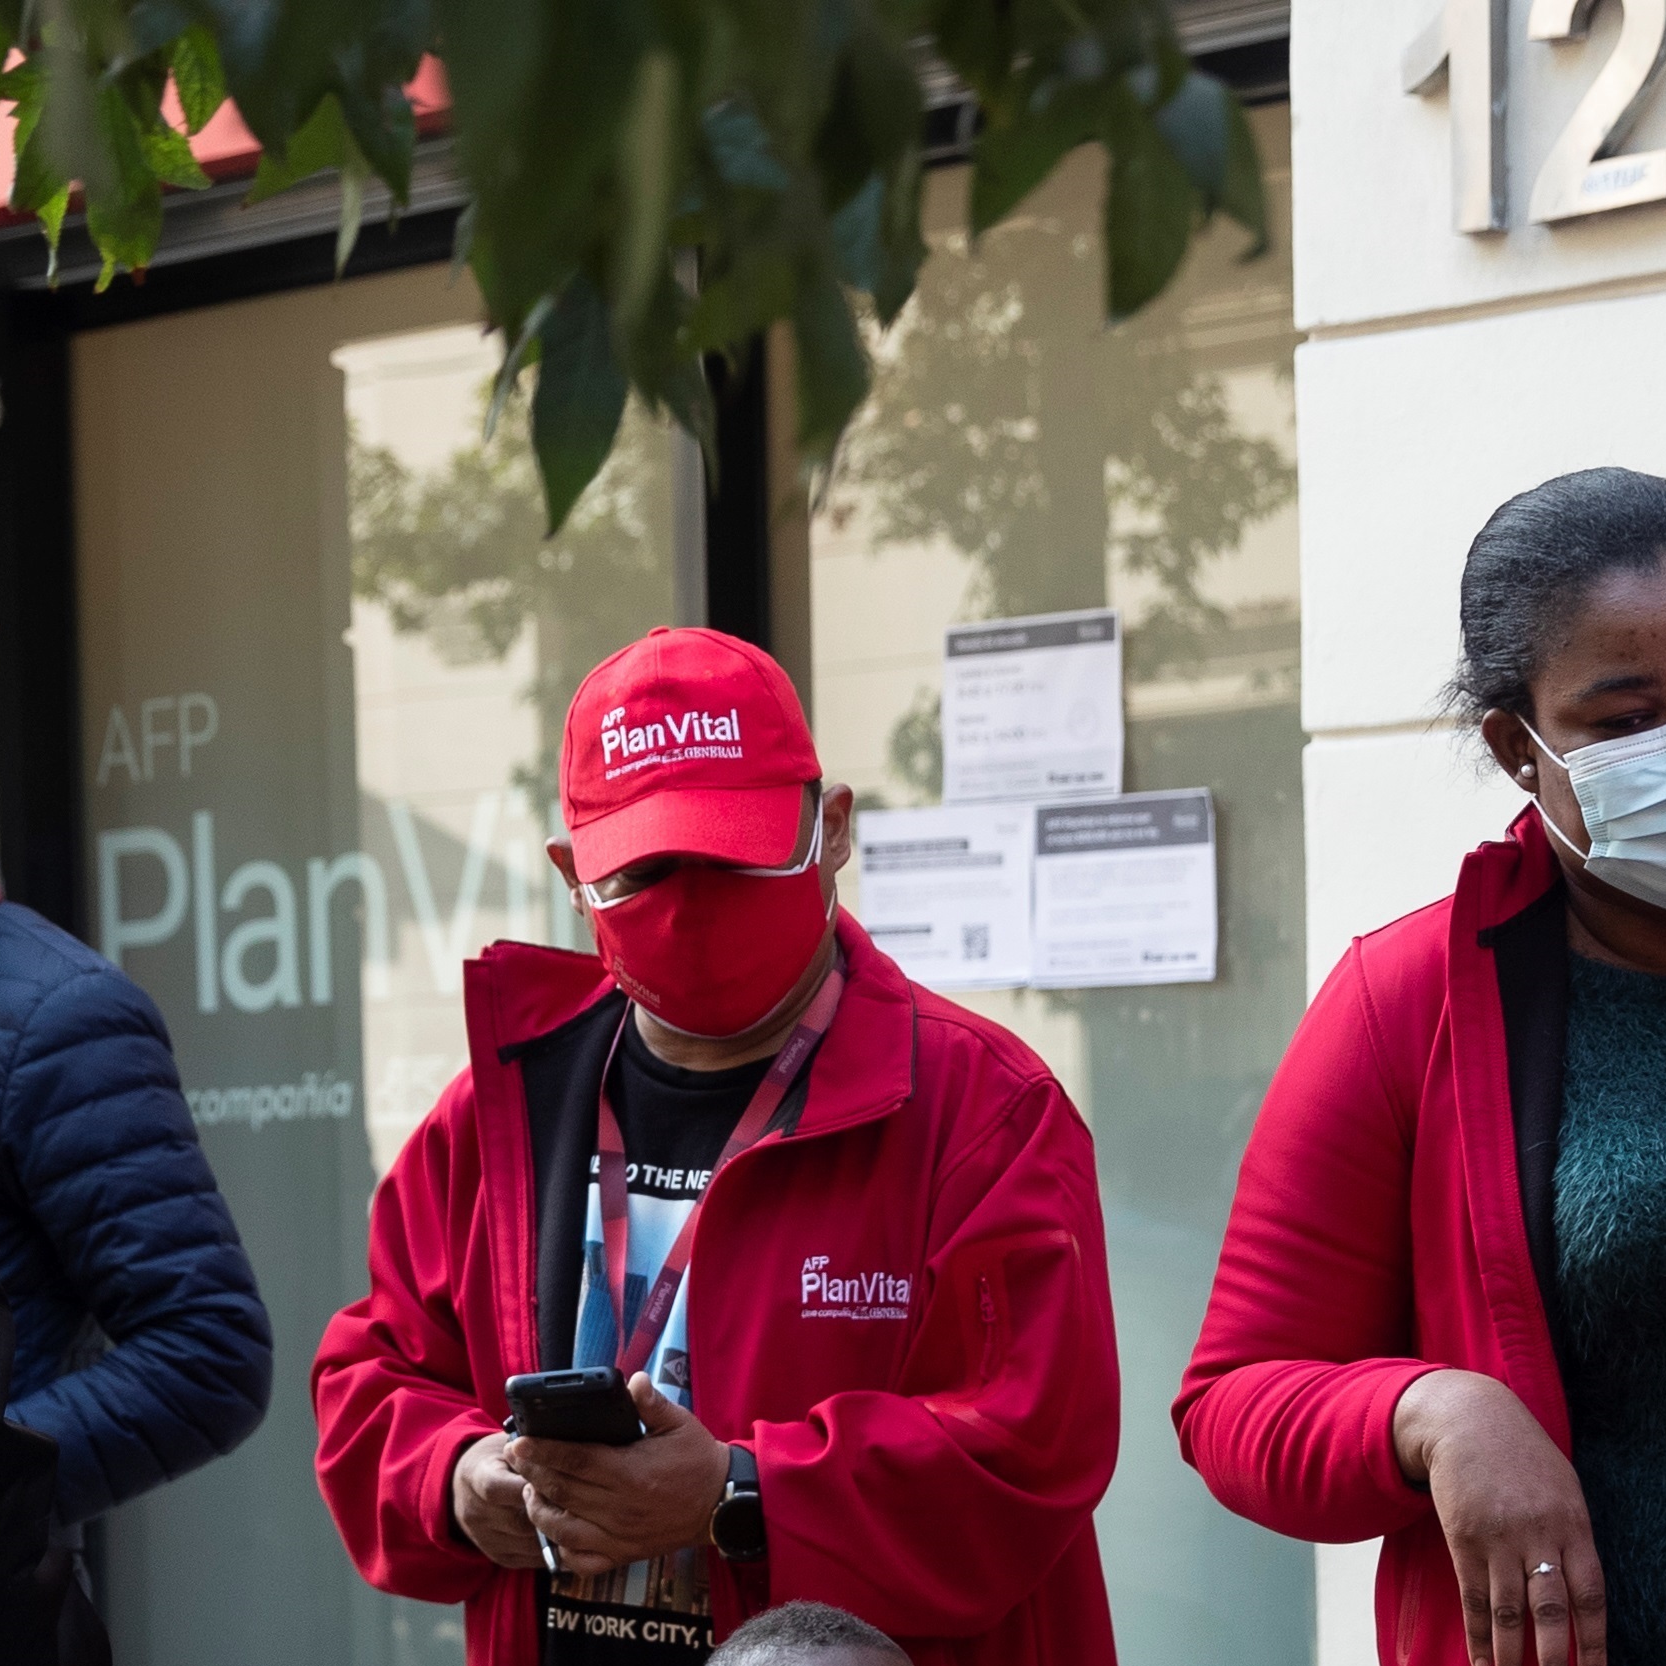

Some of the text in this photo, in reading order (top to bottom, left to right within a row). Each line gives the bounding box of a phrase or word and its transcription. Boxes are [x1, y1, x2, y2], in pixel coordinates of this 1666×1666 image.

[601, 706, 626, 730] AFP
[96, 693, 220, 787] AFP
[601, 708, 741, 765] PlanVital
[683, 746, 743, 759] GENERALI
[642, 1164, 684, 1190] THE
[801, 1255, 830, 1274] AFP
[801, 1272, 913, 1305] PlanVital
[584, 1614, 637, 1640] YORK
[641, 1620, 700, 1649] CITY,
